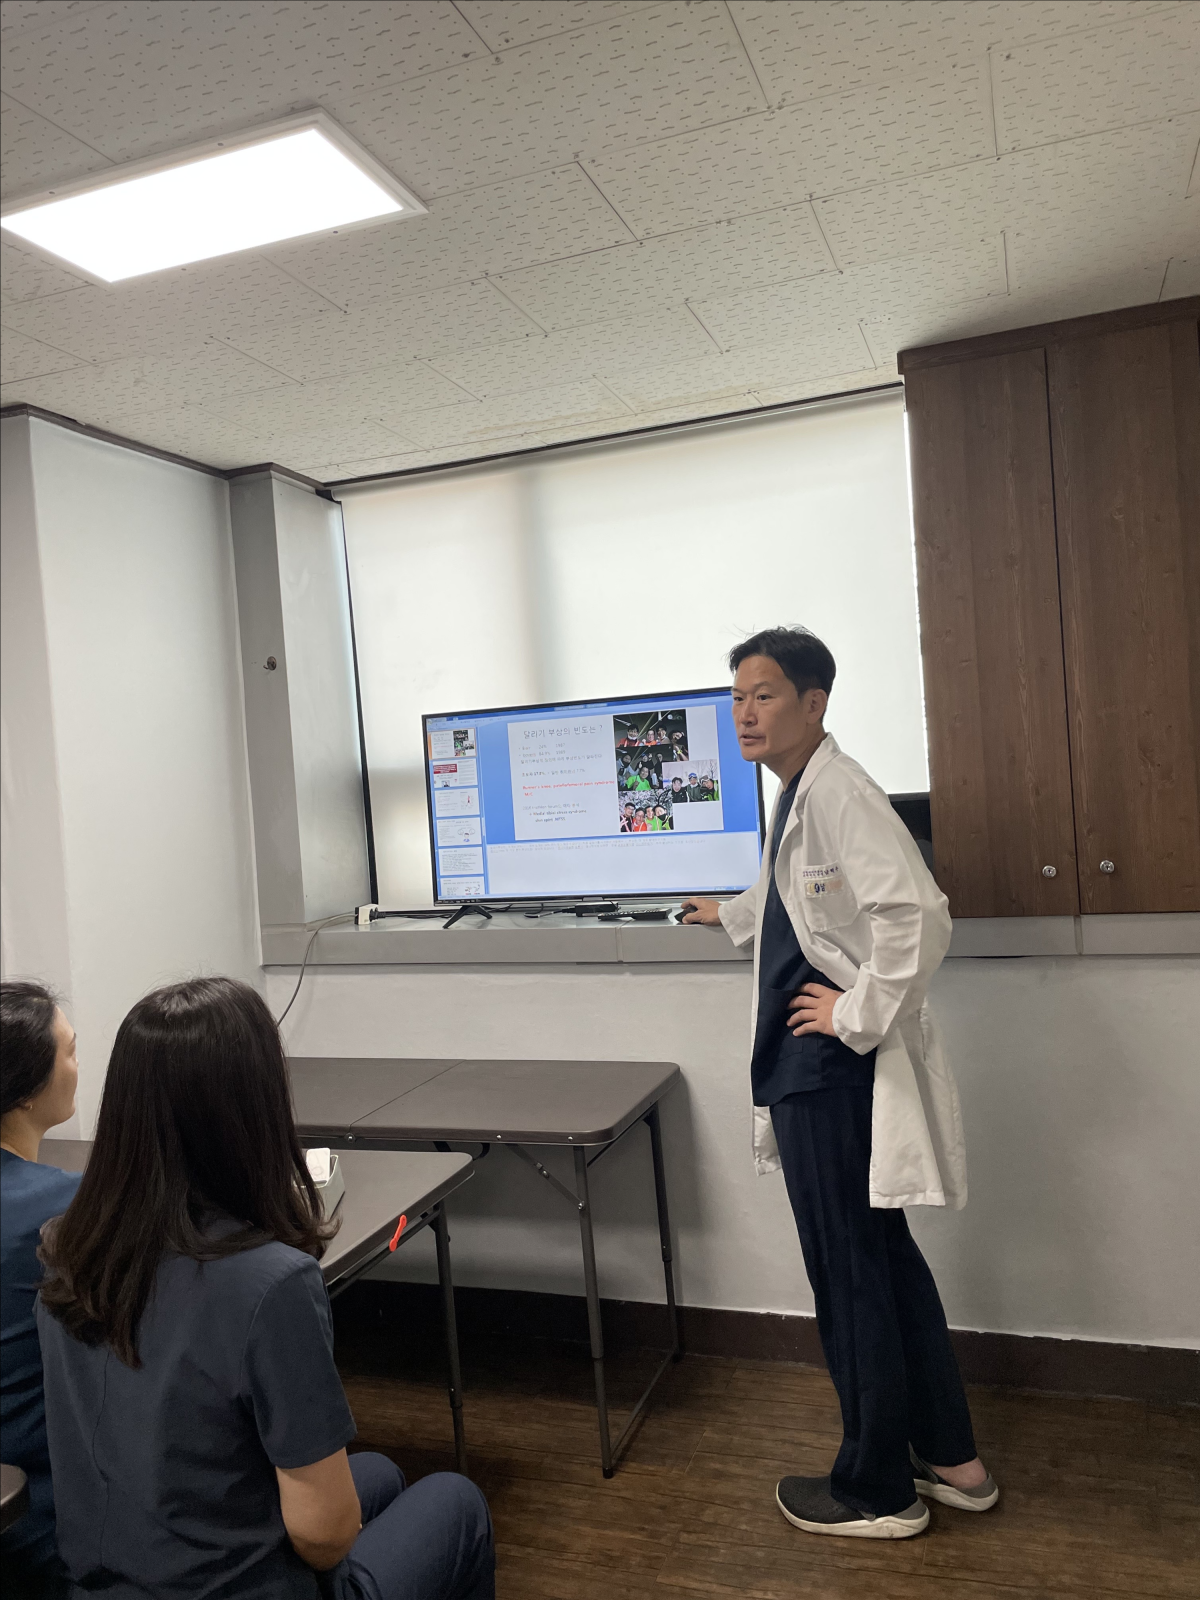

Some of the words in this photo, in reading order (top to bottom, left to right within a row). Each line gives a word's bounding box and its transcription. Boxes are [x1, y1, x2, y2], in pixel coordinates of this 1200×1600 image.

[523, 730, 545, 740] 달리기
[548, 727, 571, 736] 부상의
[573, 725, 596, 735] 빈도는
